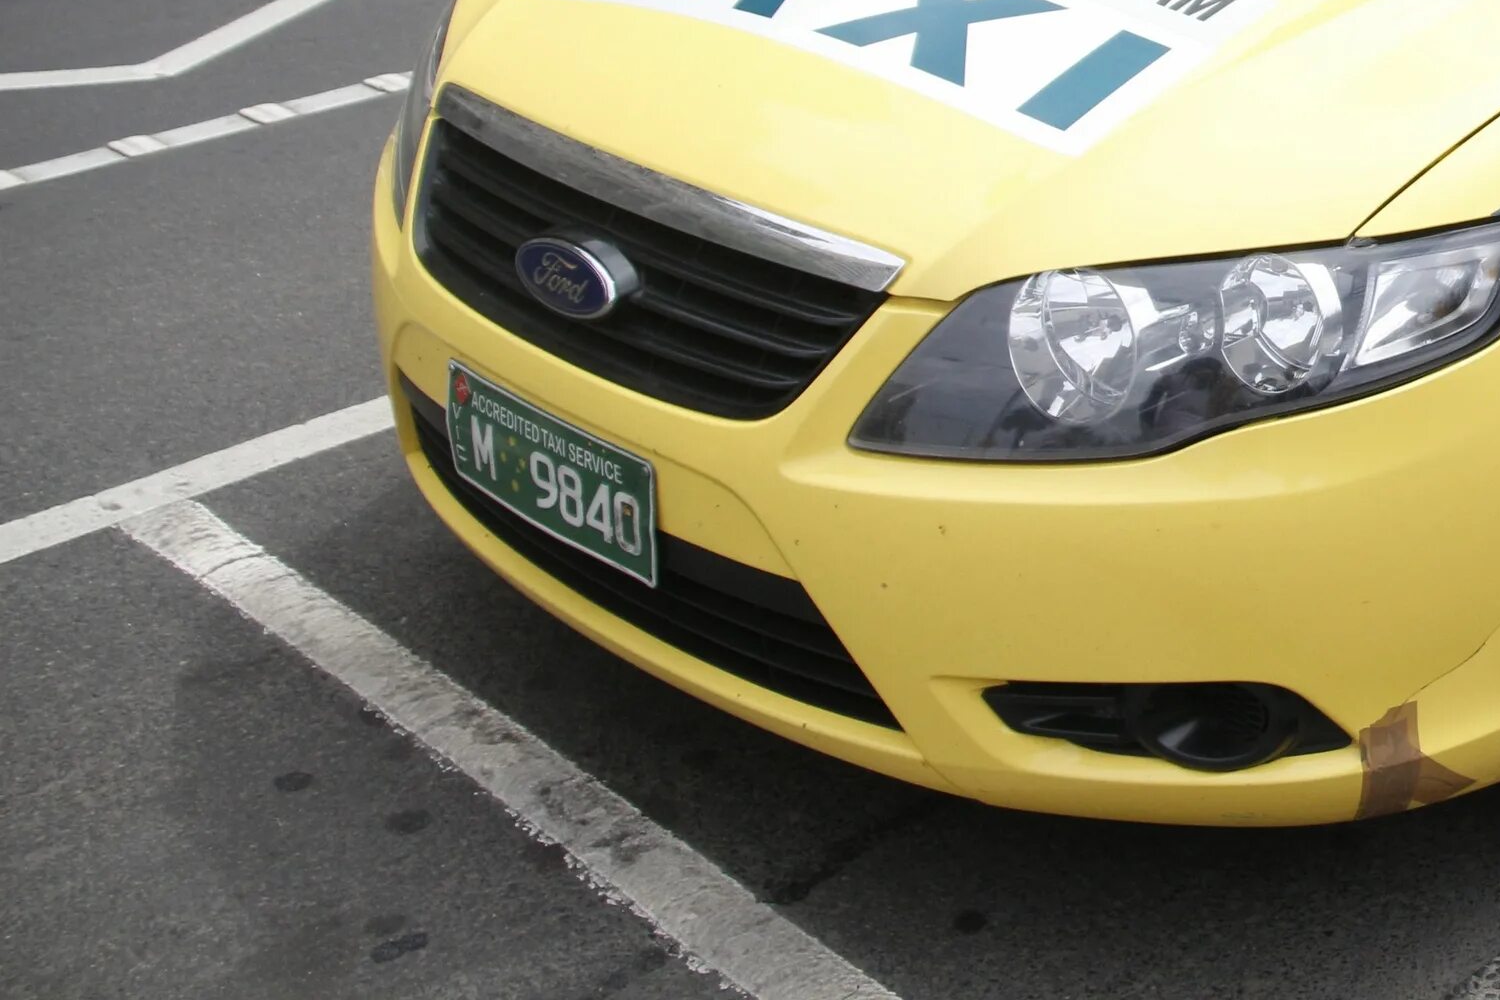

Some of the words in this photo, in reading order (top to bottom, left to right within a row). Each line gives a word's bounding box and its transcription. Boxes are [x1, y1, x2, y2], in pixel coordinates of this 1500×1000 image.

[533, 252, 592, 304] Ford
[452, 402, 468, 463] VIC
[471, 391, 540, 442] ACCREDITED
[541, 428, 566, 458] TAXI
[568, 440, 624, 485] SERVICE
[471, 415, 497, 481] M
[529, 451, 642, 556] 9840
